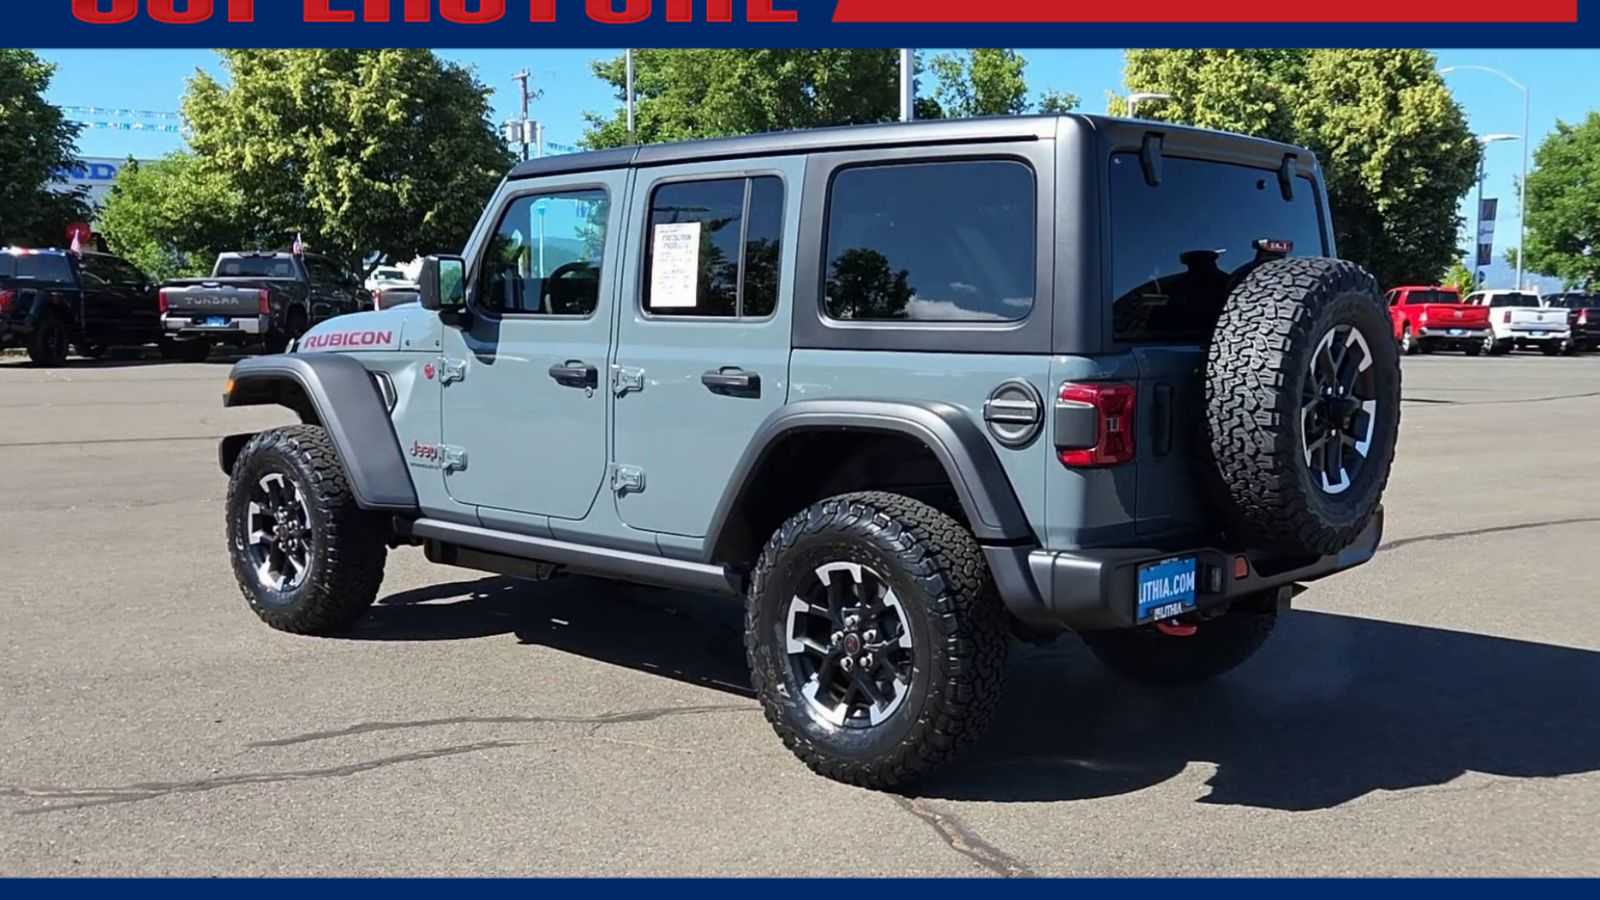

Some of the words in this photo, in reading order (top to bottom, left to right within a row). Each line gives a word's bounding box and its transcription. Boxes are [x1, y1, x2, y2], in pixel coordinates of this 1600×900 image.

[184, 297, 239, 305] TUNDRA
[304, 330, 393, 349] RUBICON
[410, 440, 438, 461] Jeep
[1138, 570, 1196, 605] LITHIA.COM
